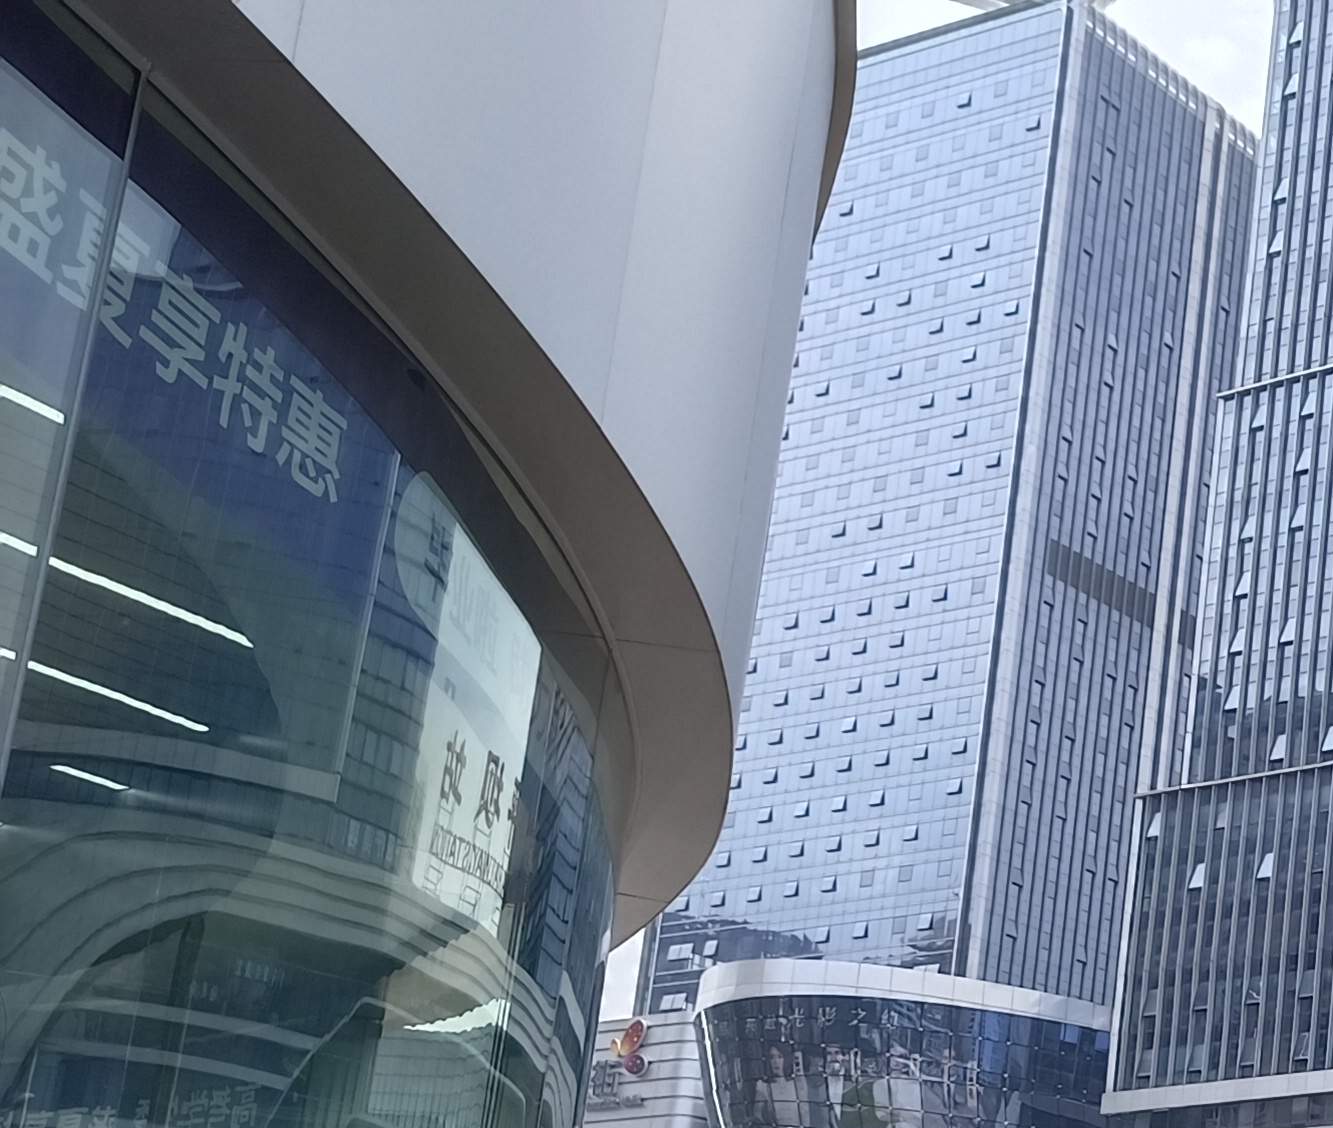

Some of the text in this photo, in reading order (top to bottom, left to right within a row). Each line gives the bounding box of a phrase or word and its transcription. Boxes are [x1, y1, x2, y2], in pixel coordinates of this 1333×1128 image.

[0, 128, 347, 502] 盛夏享特惠
